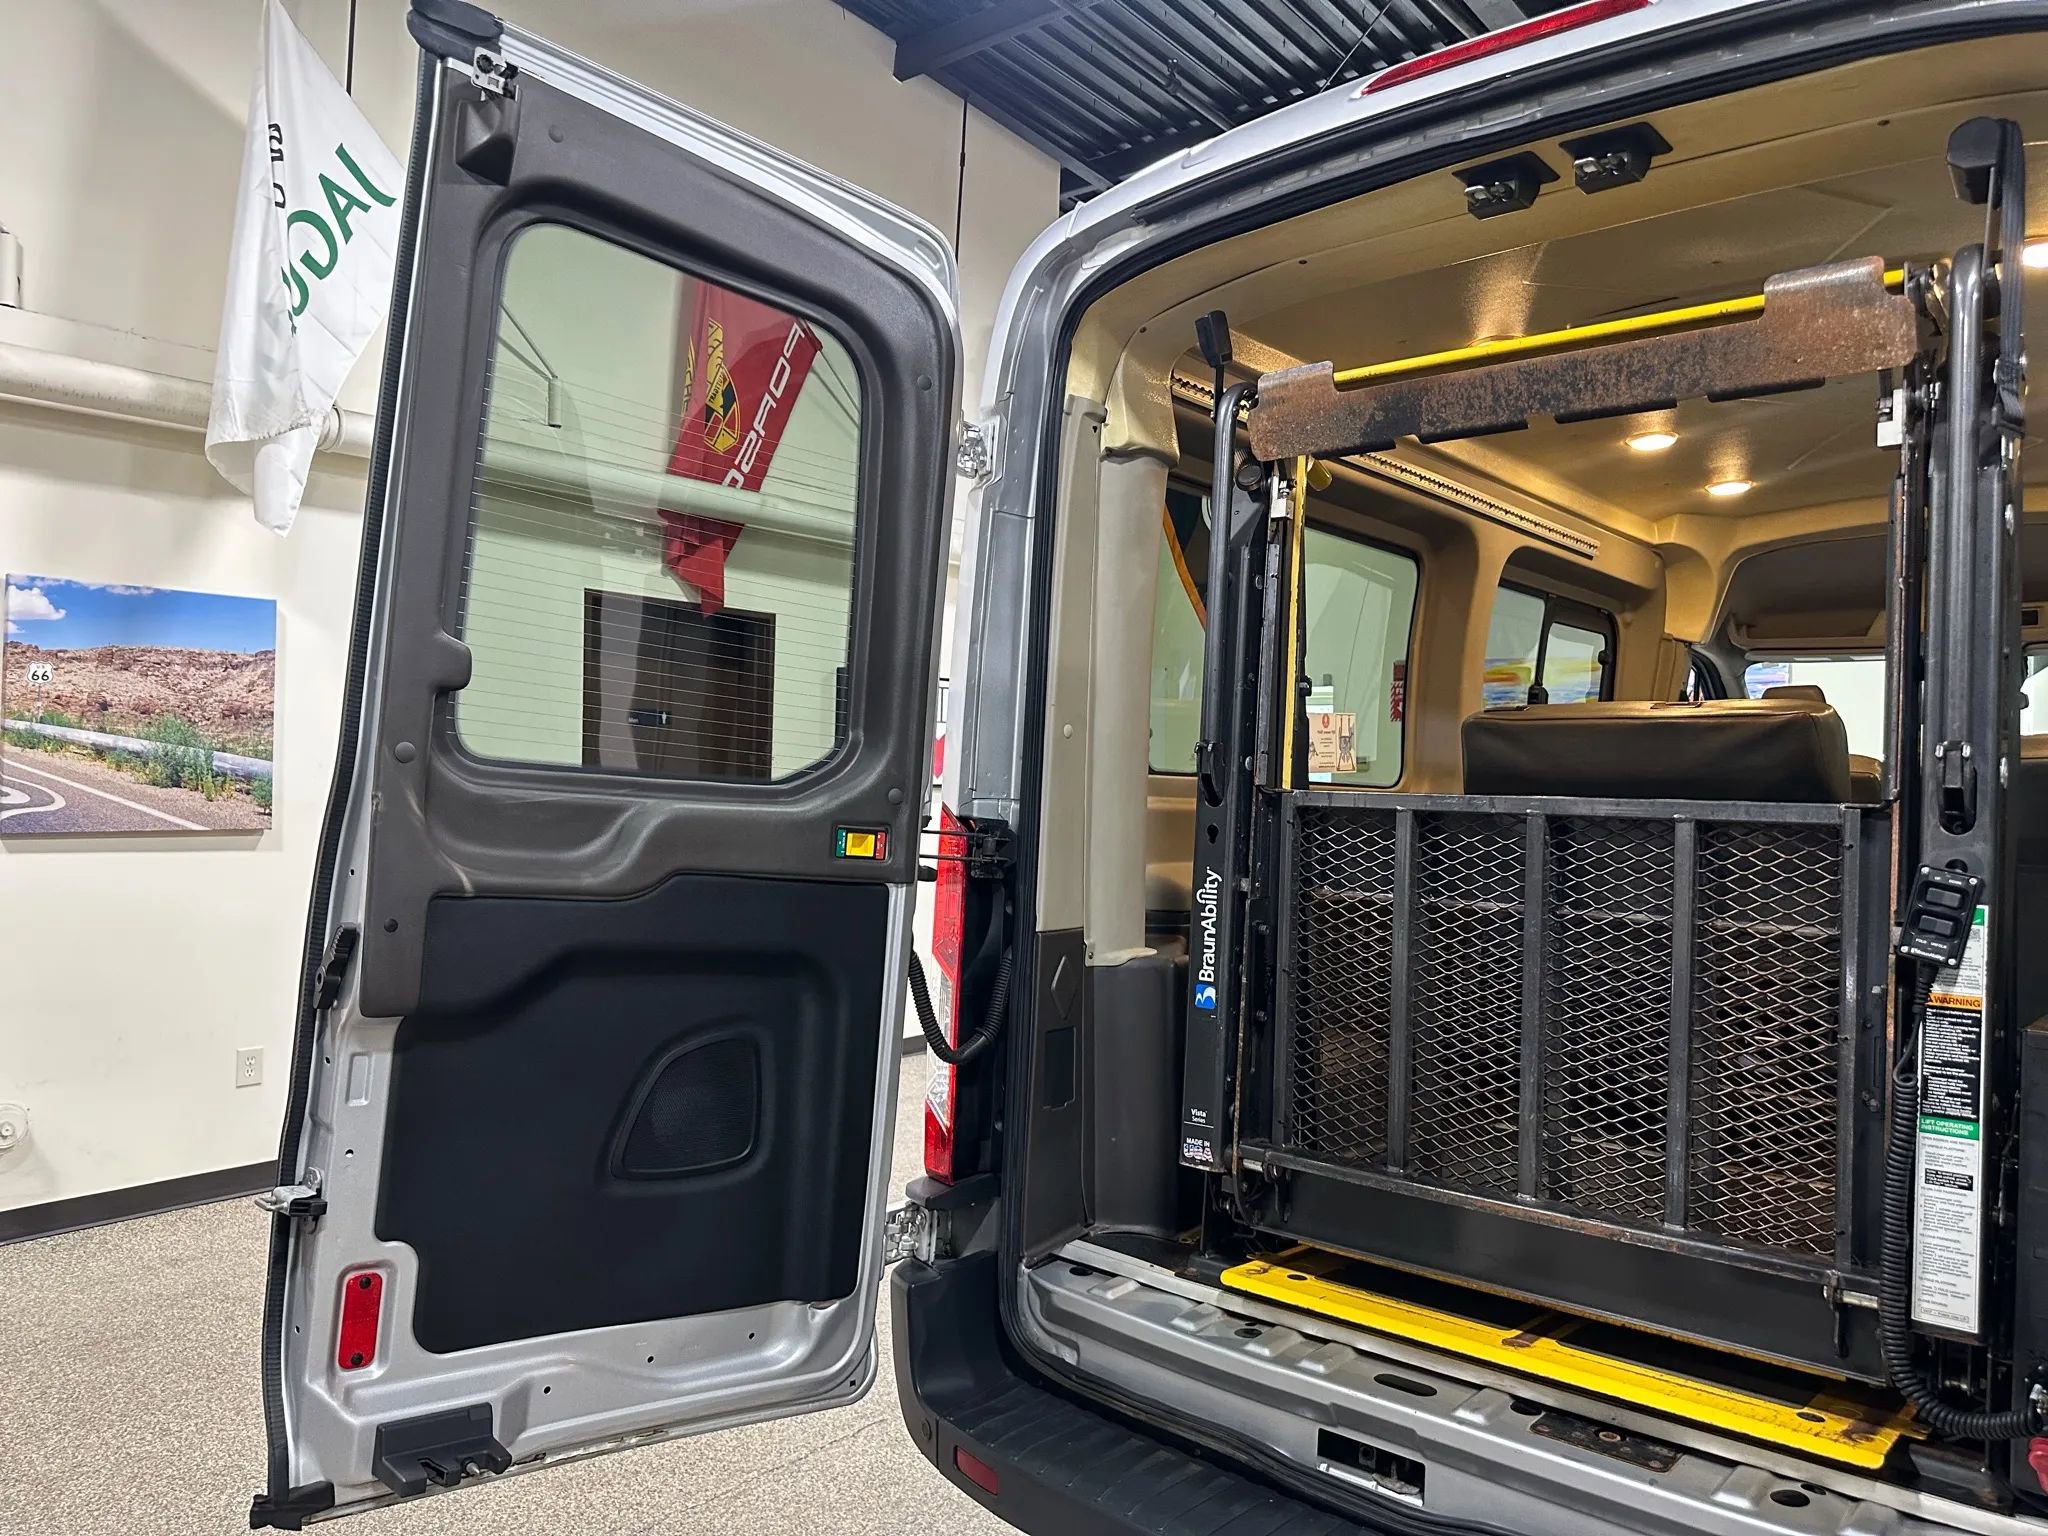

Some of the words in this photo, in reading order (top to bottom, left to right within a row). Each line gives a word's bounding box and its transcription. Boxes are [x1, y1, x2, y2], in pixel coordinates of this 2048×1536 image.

[31, 670, 50, 681] 66
[1196, 869, 1223, 983] BraunAbility
[1933, 994, 1981, 1008] WARNING
[1920, 1124, 1969, 1136] INSTRUCTIONS
[1935, 1120, 1974, 1131] OPERATING
[1186, 1137, 1203, 1146] MADE
[1203, 1140, 1211, 1148] IN
[1183, 1142, 1214, 1163] USA
